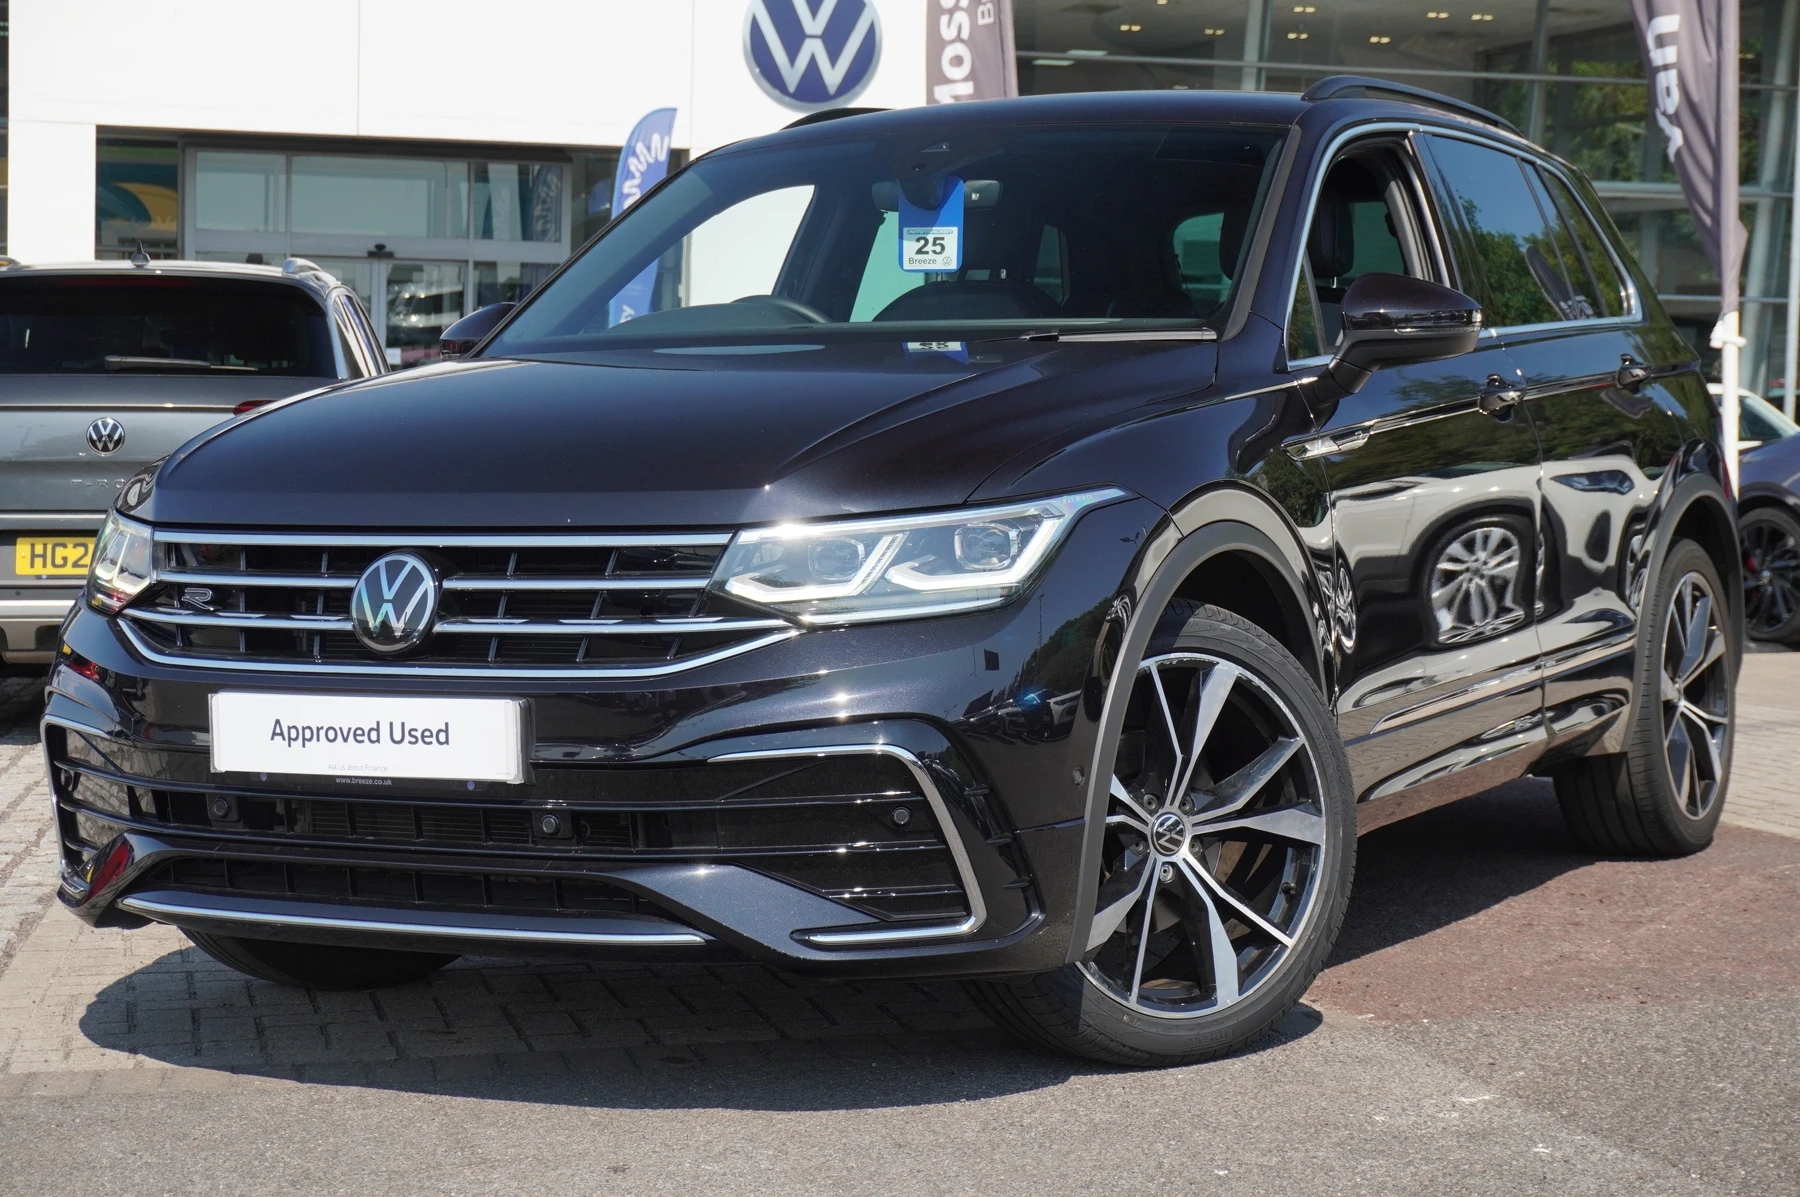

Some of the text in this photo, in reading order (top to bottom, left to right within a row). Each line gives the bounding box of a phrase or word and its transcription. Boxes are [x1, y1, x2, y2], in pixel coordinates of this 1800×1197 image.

[915, 236, 946, 255] 25
[908, 257, 937, 265] Breeze
[71, 478, 126, 489] T-RO
[30, 542, 89, 569] HG2
[270, 718, 450, 748] Approved Used
[328, 763, 337, 771] Ask
[347, 764, 364, 772] about
[365, 764, 388, 772] Finance
[335, 776, 392, 786] www.breeze.co.uk
